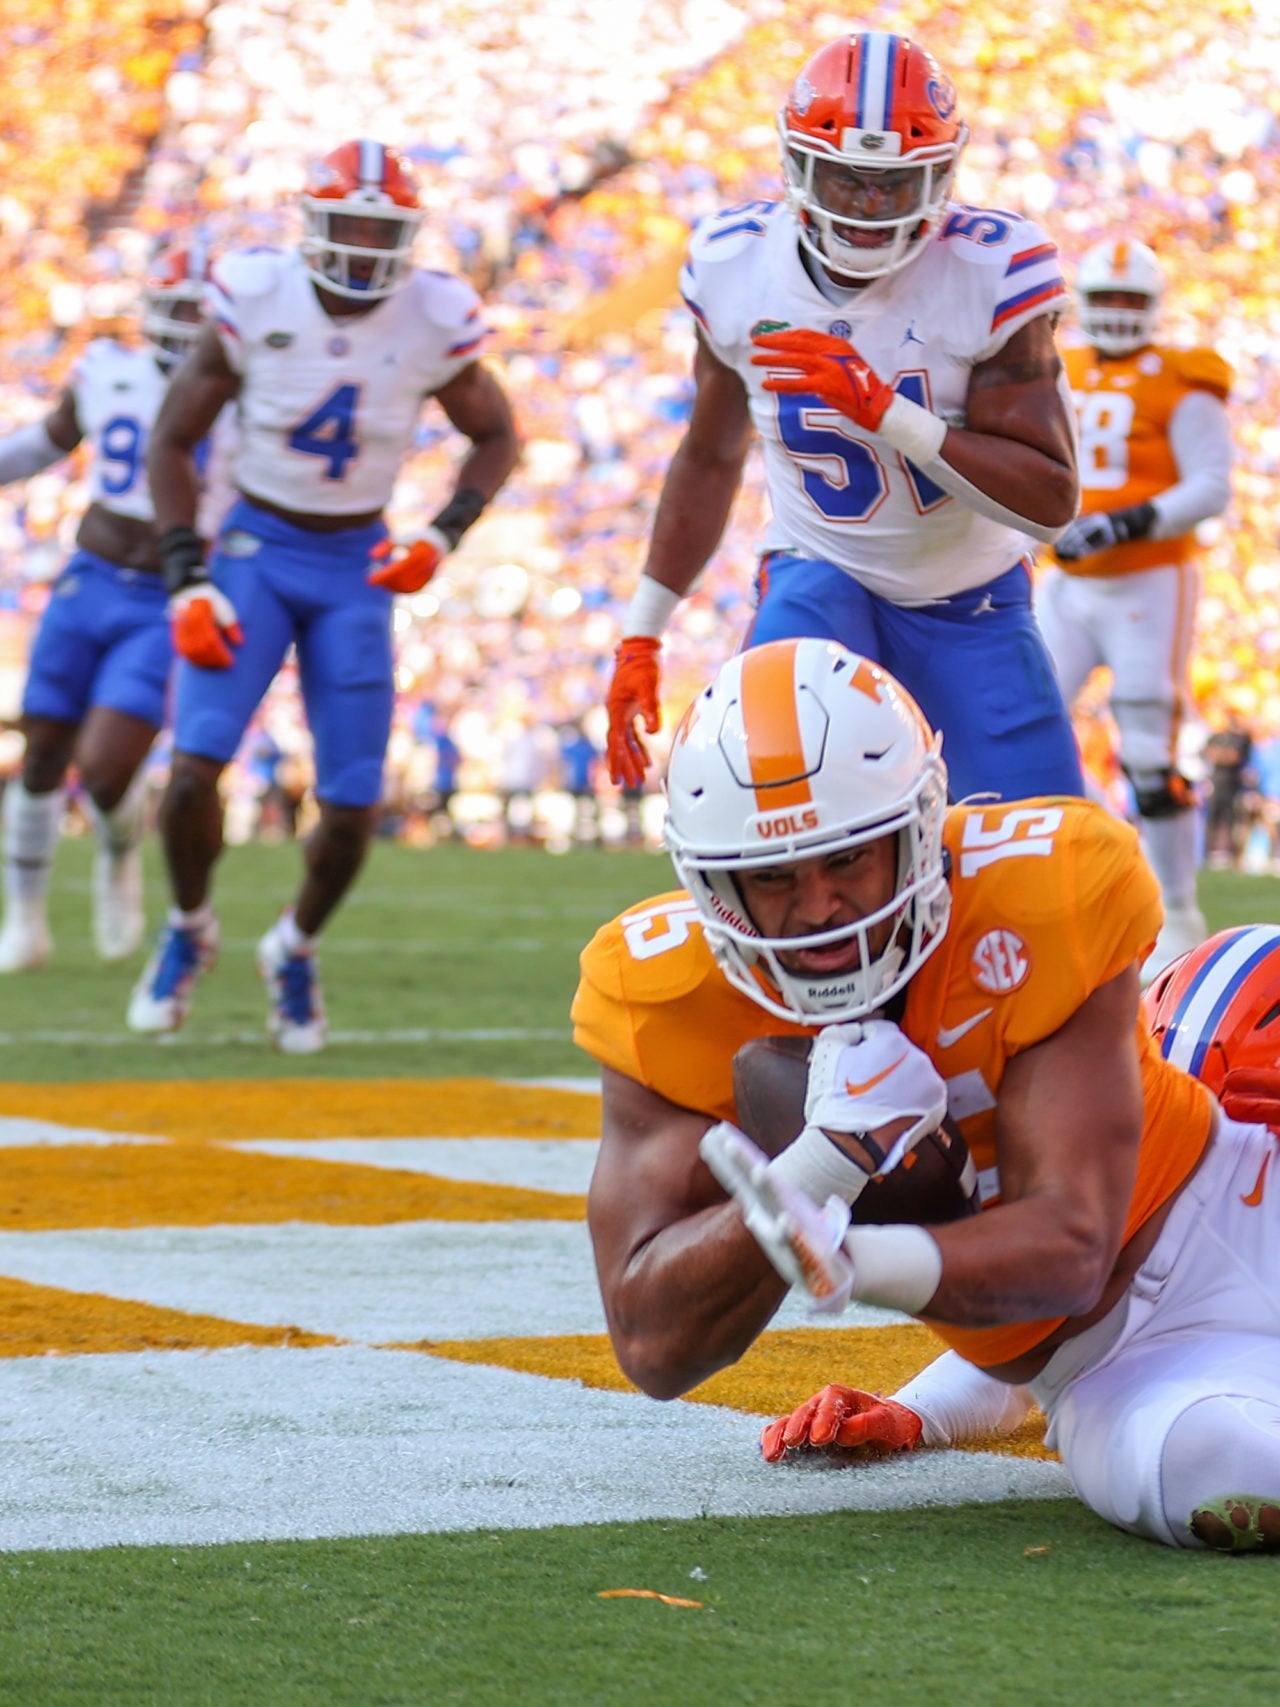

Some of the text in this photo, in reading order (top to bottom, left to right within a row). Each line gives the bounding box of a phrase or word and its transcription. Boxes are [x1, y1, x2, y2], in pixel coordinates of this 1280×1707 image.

[101, 415, 142, 497] 9
[286, 377, 363, 482] 4
[1070, 389, 1136, 490] 8
[757, 808, 819, 839] VOLS
[960, 807, 1064, 878] 15
[621, 900, 702, 961] 15
[973, 929, 1030, 992] SEC
[808, 981, 856, 999] Riddell
